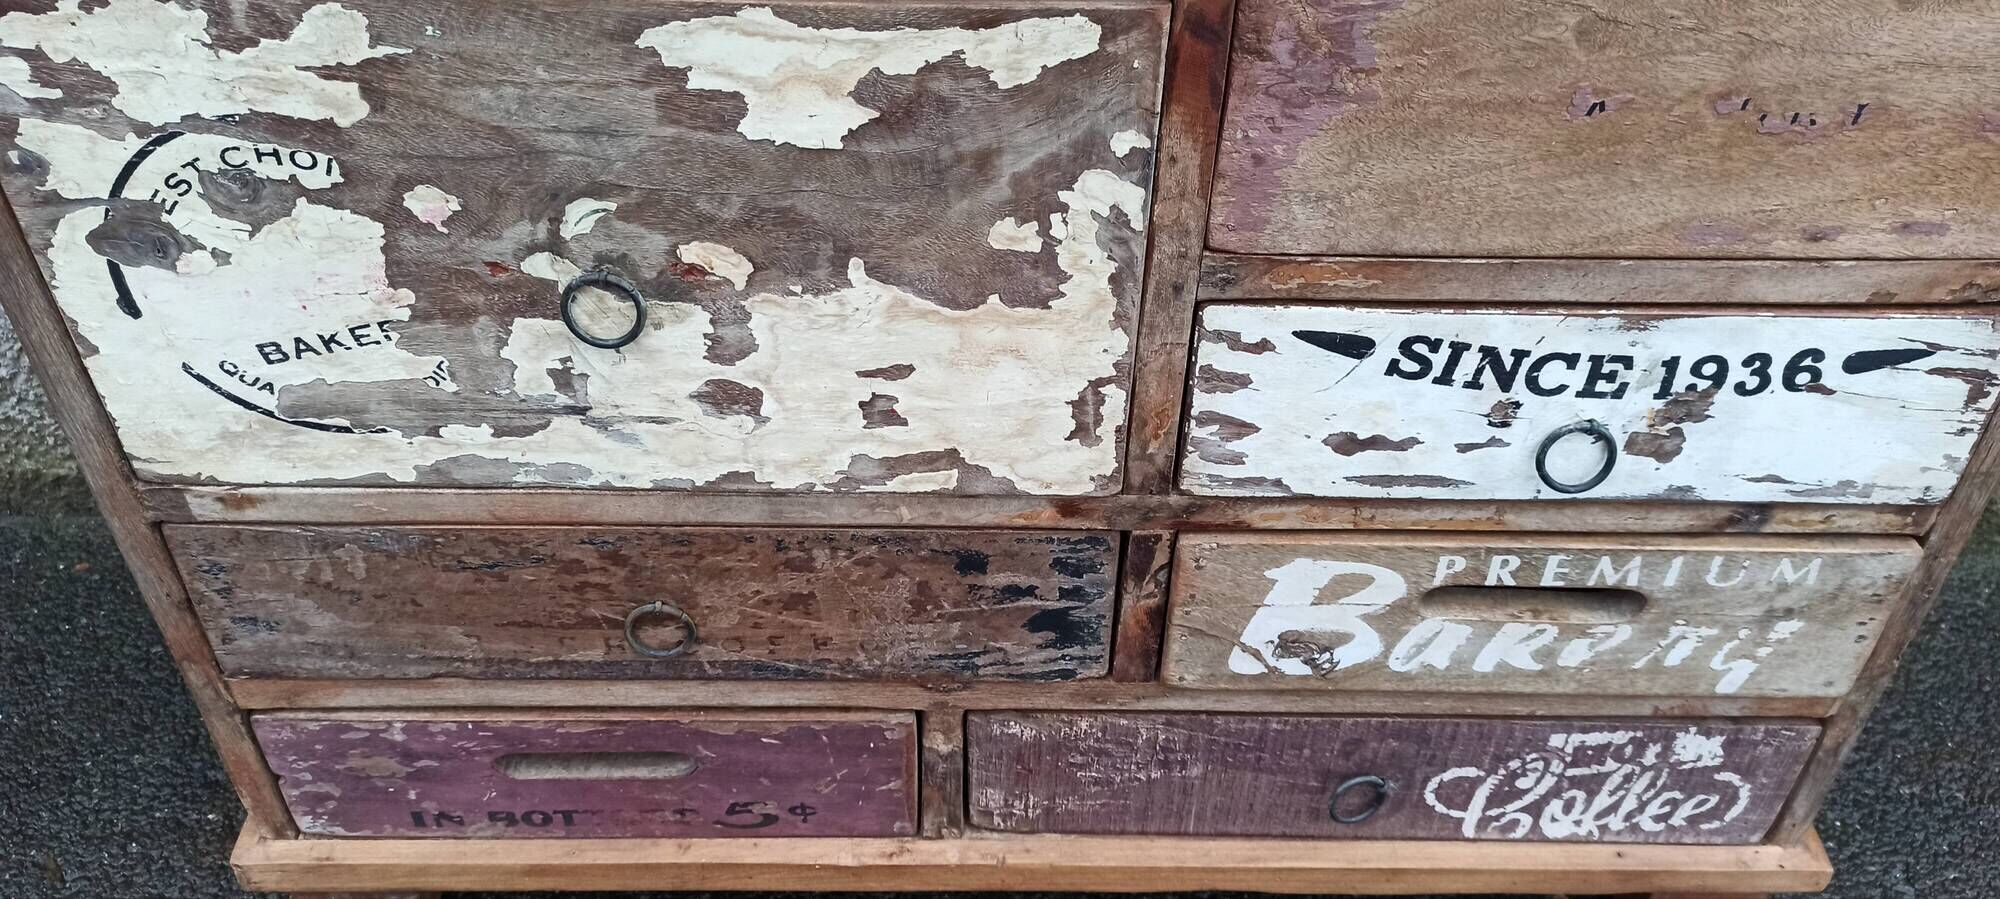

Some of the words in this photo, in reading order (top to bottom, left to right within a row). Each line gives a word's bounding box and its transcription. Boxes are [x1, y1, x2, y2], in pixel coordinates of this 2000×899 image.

[1384, 335, 1634, 400] SINCE
[1656, 347, 1826, 399] 1936
[1433, 554, 1823, 588] PREMIUM
[410, 810, 465, 828] IN
